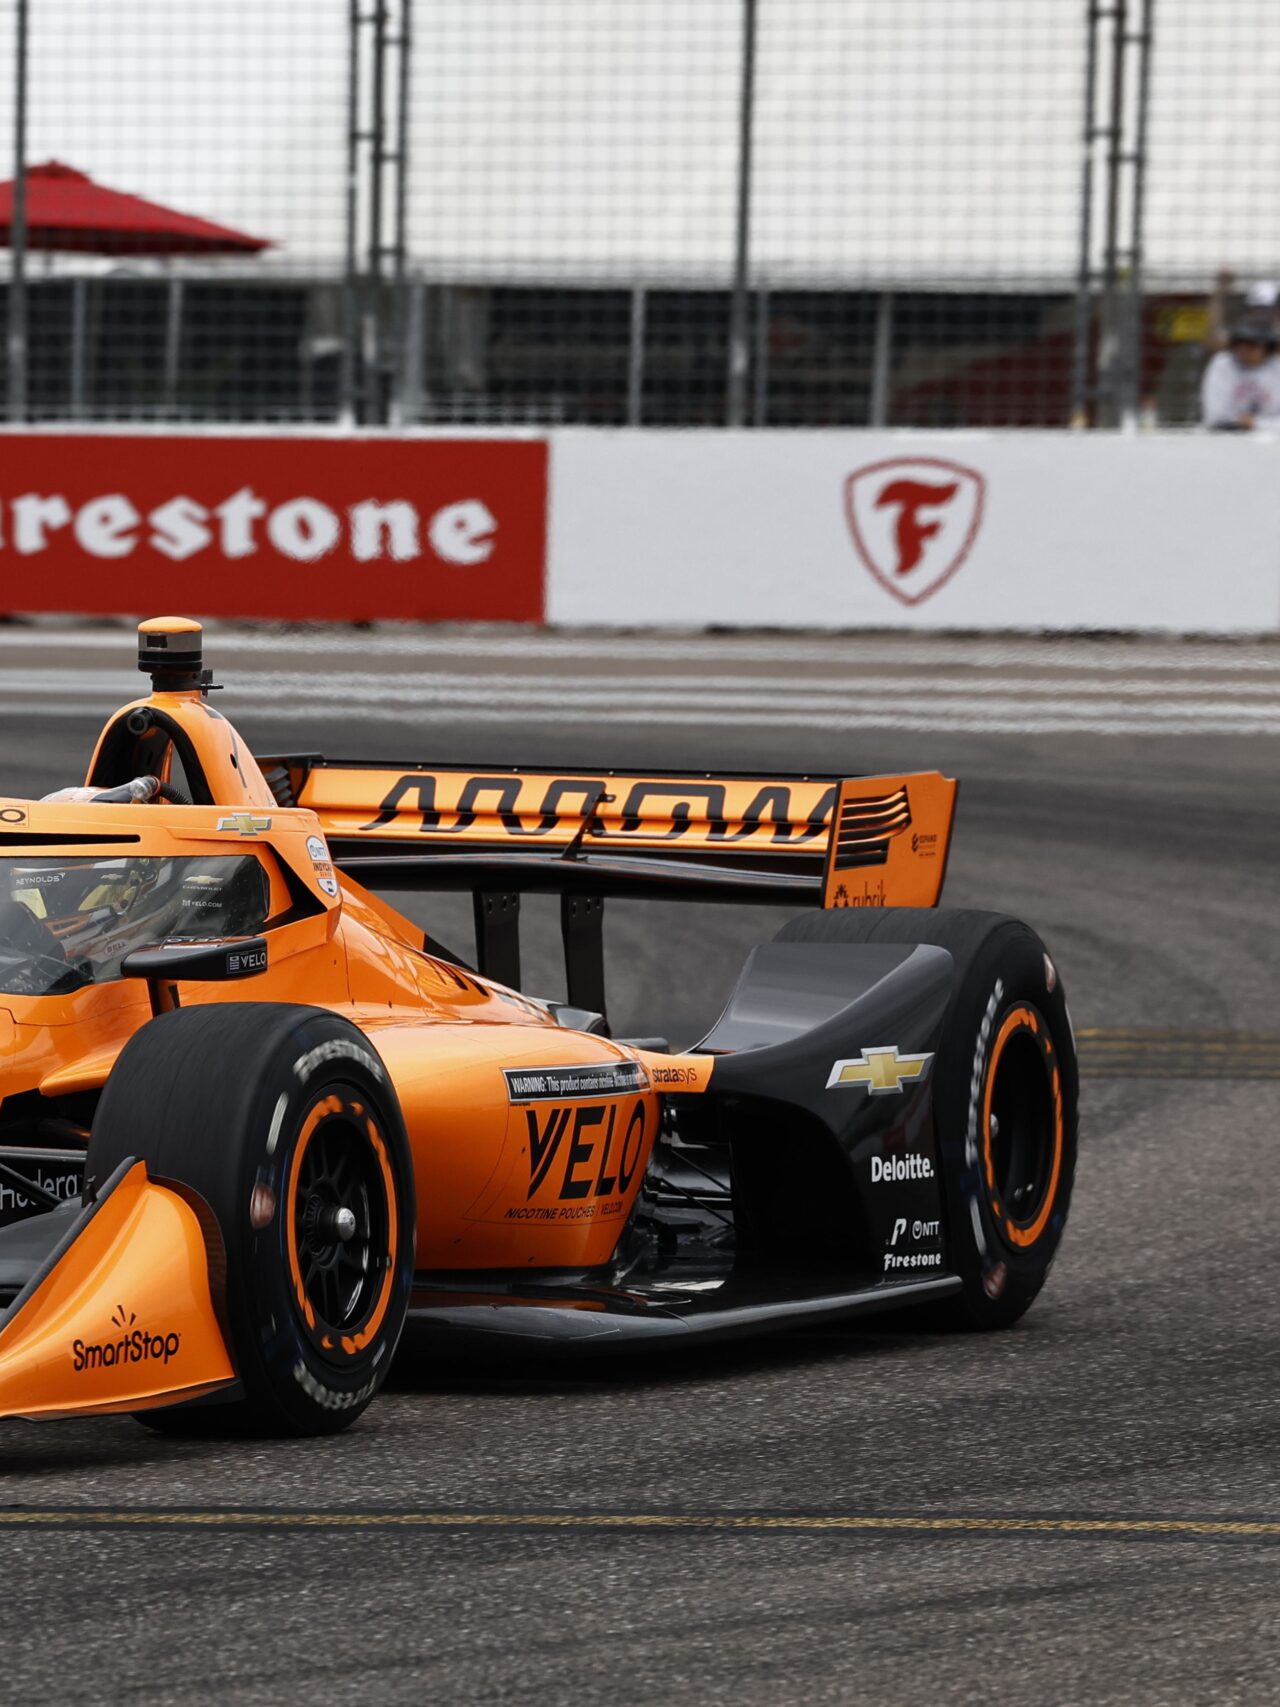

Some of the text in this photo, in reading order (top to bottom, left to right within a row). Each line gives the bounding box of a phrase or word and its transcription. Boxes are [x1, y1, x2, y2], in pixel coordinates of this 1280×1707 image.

[358, 774, 837, 845] ARROW
[16, 875, 60, 885] REYNOLDS
[240, 952, 266, 968] VELO
[511, 1075, 547, 1093] WARNING:
[547, 1074, 560, 1093] This
[560, 1074, 580, 1095] product
[652, 1067, 698, 1085] stratasys
[525, 1098, 646, 1202] VELO
[871, 1153, 934, 1182] Deloitte.
[504, 1206, 558, 1220] NICOTINE
[558, 1203, 596, 1219] POUCHES
[922, 1221, 940, 1236] NTT
[884, 1252, 942, 1272] Firestone
[73, 1330, 180, 1372] SmartStop
